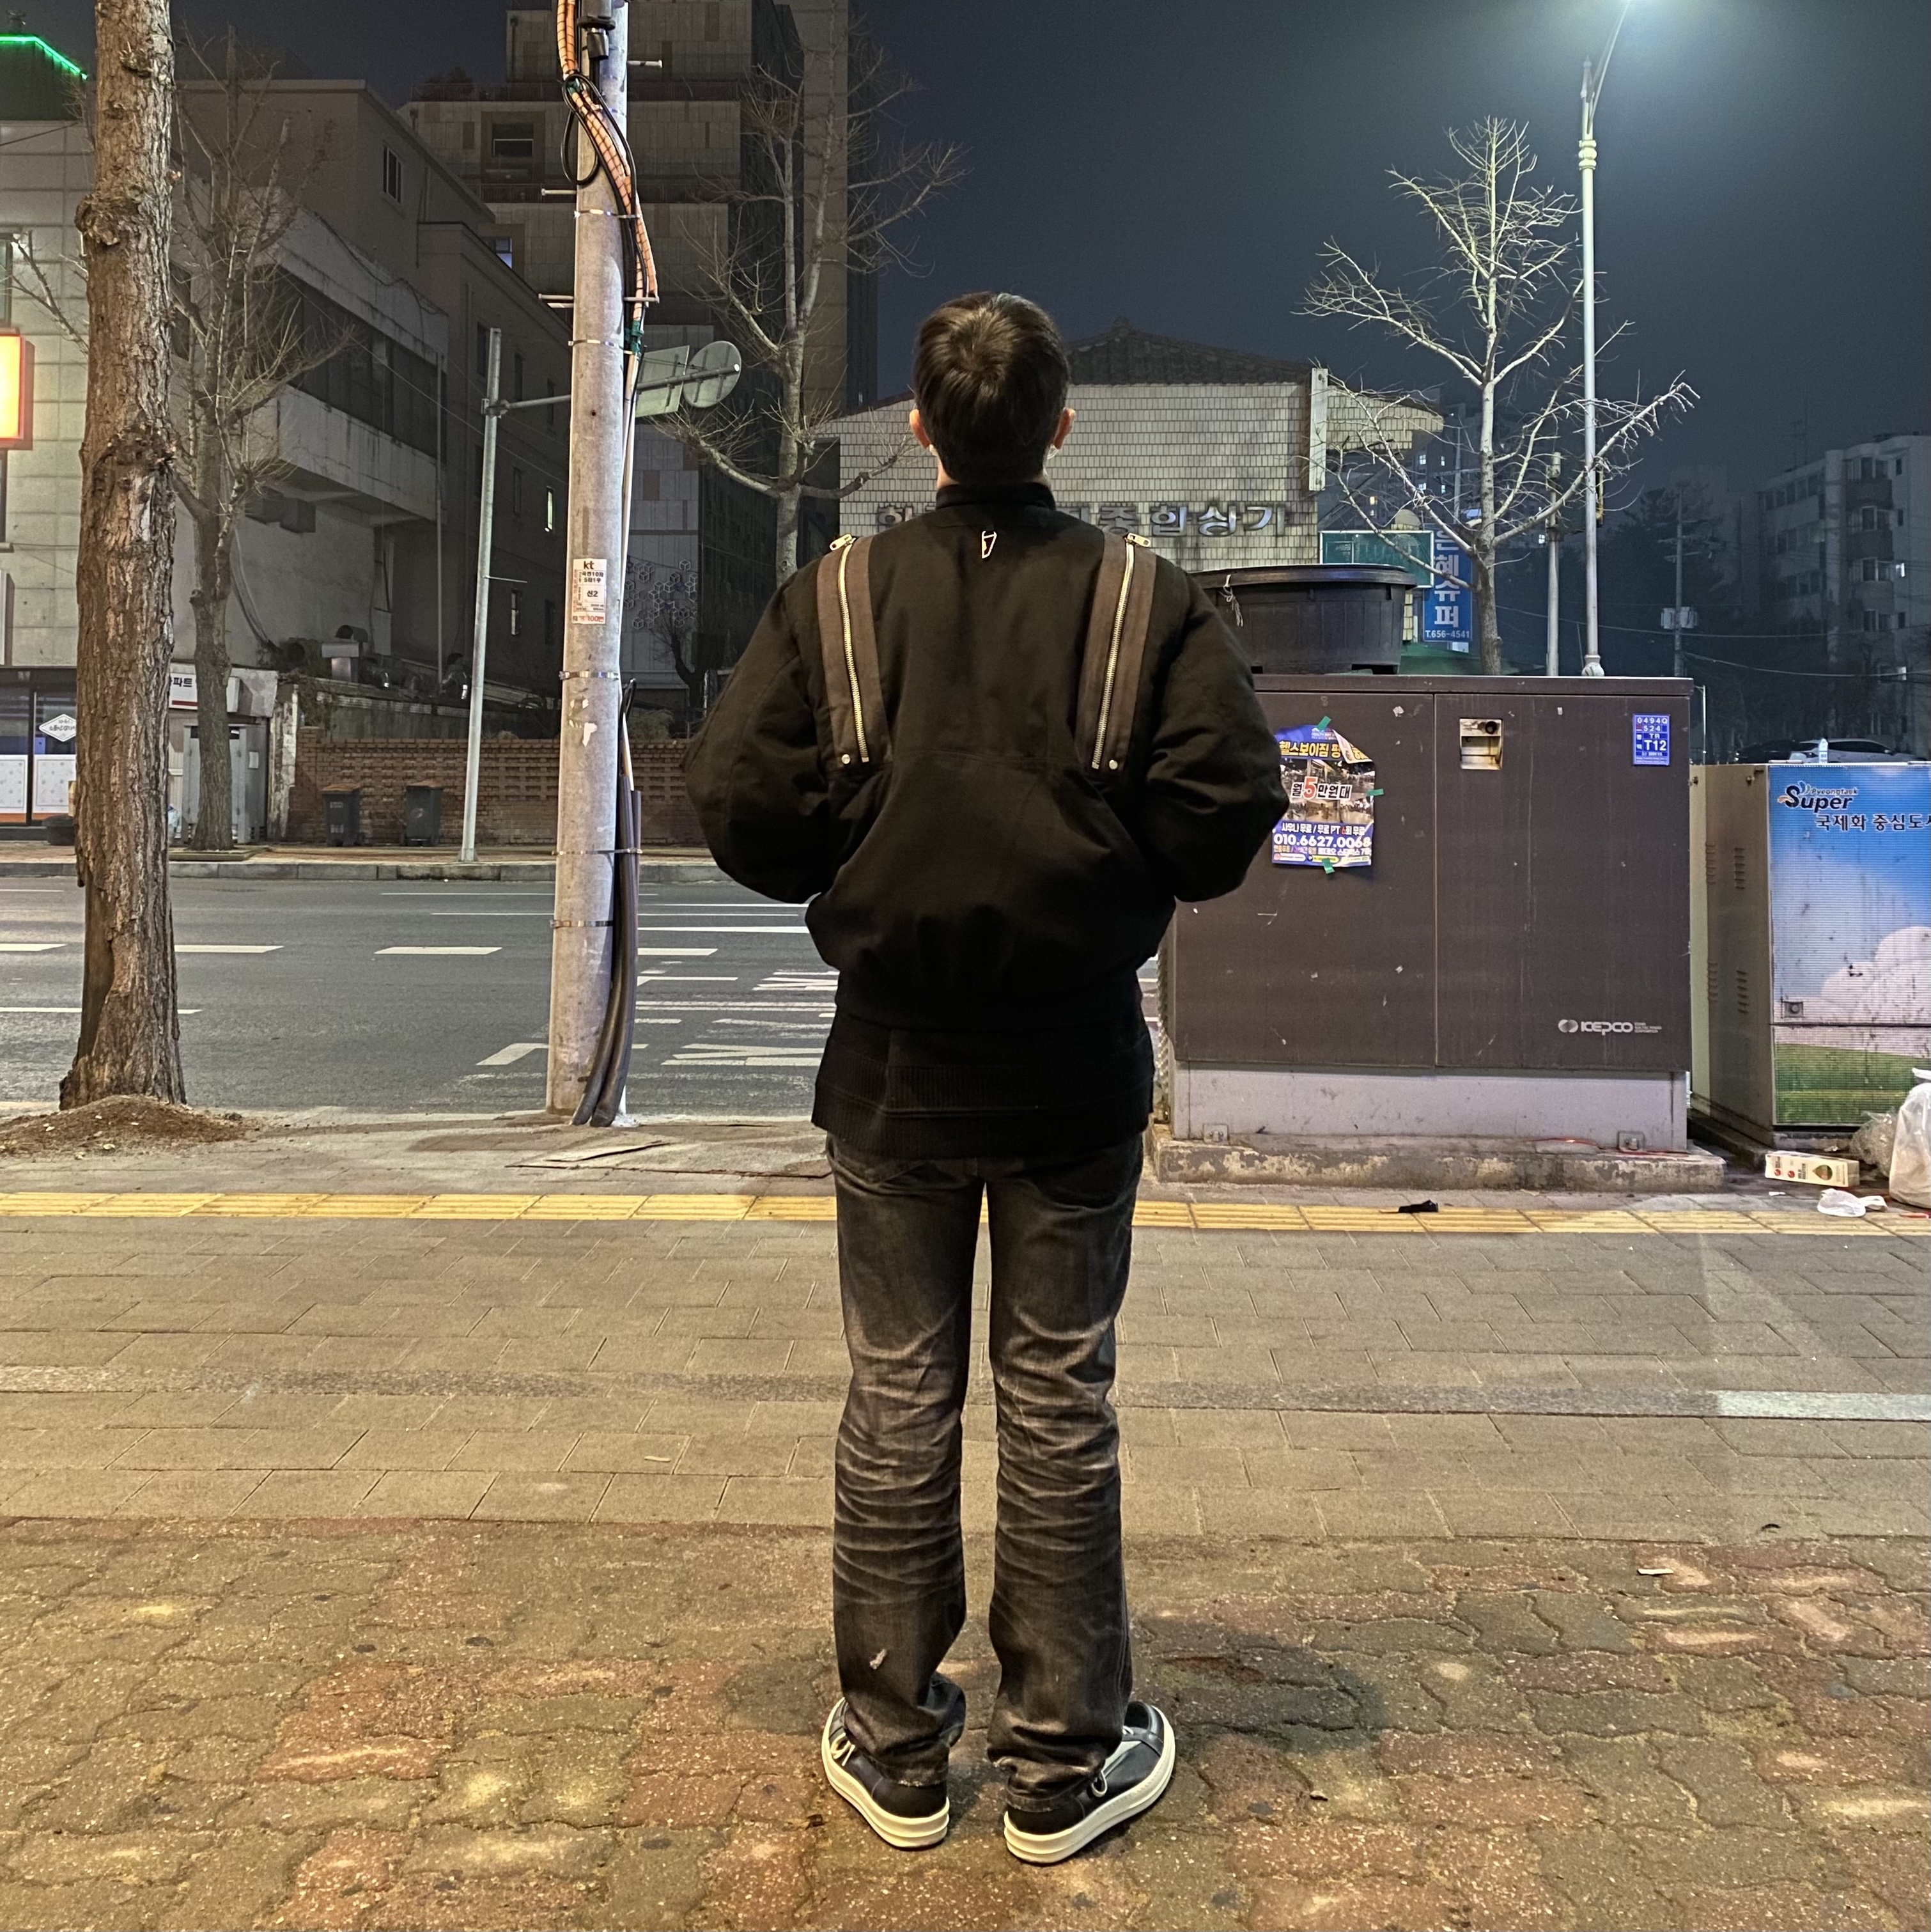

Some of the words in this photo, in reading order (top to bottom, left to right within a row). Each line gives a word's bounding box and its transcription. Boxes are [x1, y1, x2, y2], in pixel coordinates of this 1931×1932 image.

[583, 561, 594, 570] kt
[1433, 529, 1461, 628] 은혜슈퍼
[1425, 630, 1470, 639] T.656-4541
[171, 677, 192, 688] 파트
[1279, 741, 1329, 758] 헬스보이짐
[1643, 740, 1667, 751] T12
[1785, 784, 1853, 813] Super
[1816, 814, 1866, 831] 국제화
[1273, 834, 1372, 848] 010.6627.0068
